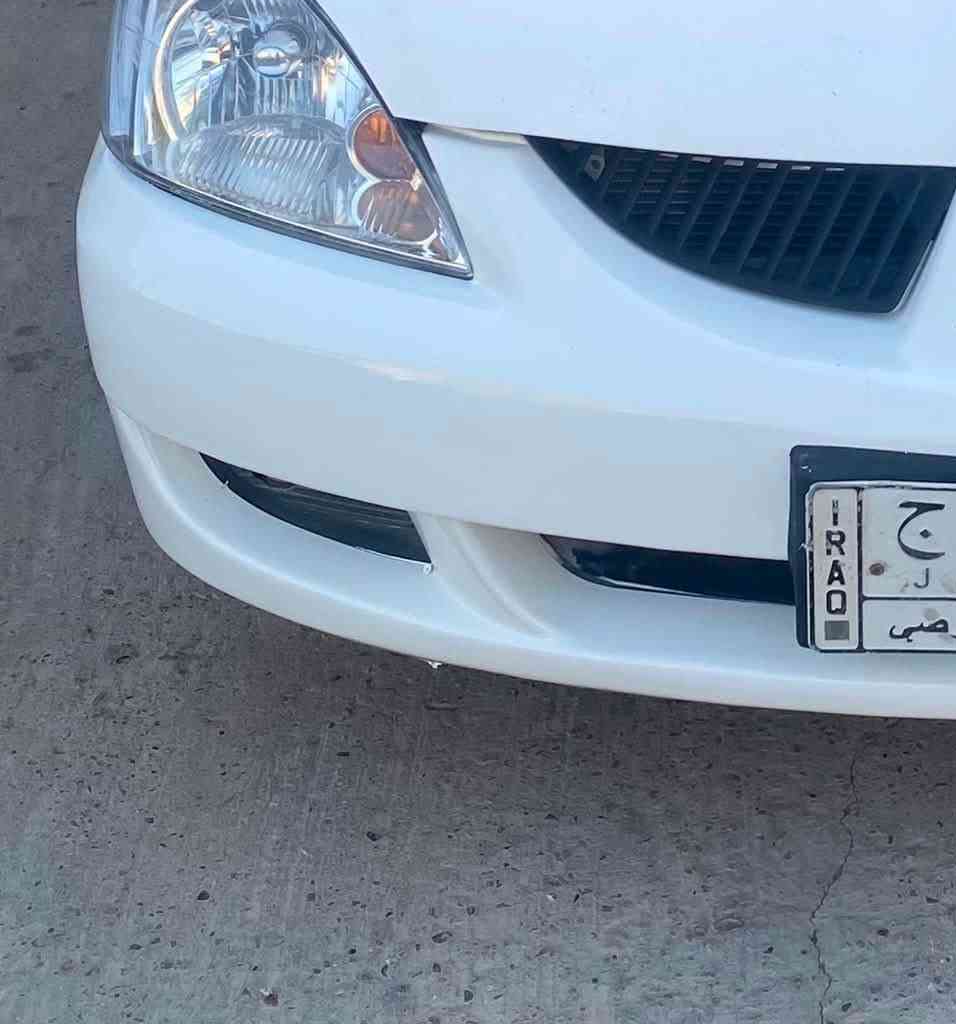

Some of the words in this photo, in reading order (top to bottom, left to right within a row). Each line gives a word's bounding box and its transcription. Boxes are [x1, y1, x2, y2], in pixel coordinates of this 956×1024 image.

[825, 498, 848, 615] IRAQ
[897, 500, 946, 561] ج
[913, 567, 930, 589] J
